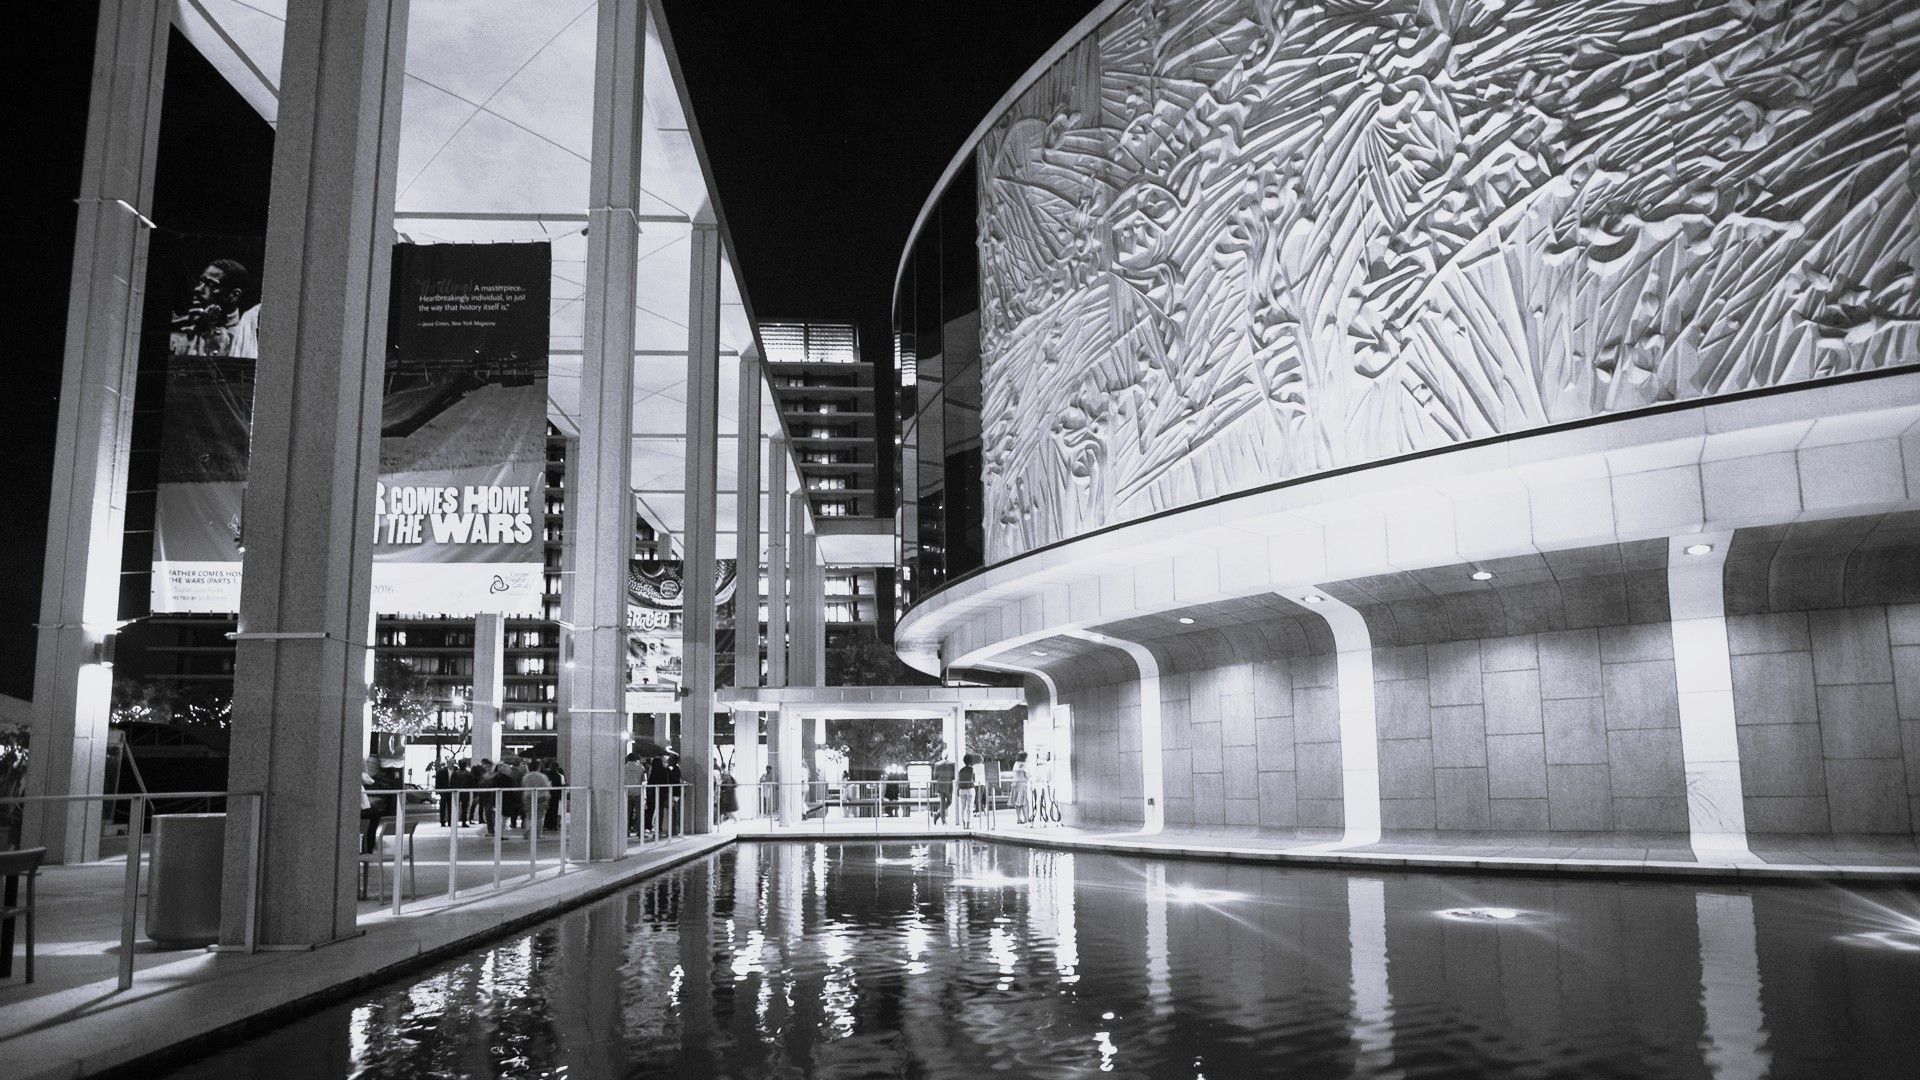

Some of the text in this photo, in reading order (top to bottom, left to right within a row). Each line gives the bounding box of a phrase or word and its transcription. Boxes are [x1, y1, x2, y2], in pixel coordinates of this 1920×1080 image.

[474, 284, 481, 292] A
[419, 294, 470, 303] Heartbreakingly
[471, 293, 505, 302] individual,
[514, 294, 526, 303] just
[419, 304, 430, 312] the
[431, 304, 443, 313] way
[445, 303, 458, 312] that
[460, 303, 482, 313] history
[483, 303, 500, 311] itself
[391, 486, 459, 515] COMES
[463, 485, 530, 514] HOME
[387, 513, 424, 544] THE
[430, 512, 533, 544] WARS
[168, 569, 197, 577] FATHER
[373, 584, 394, 595] 2016
